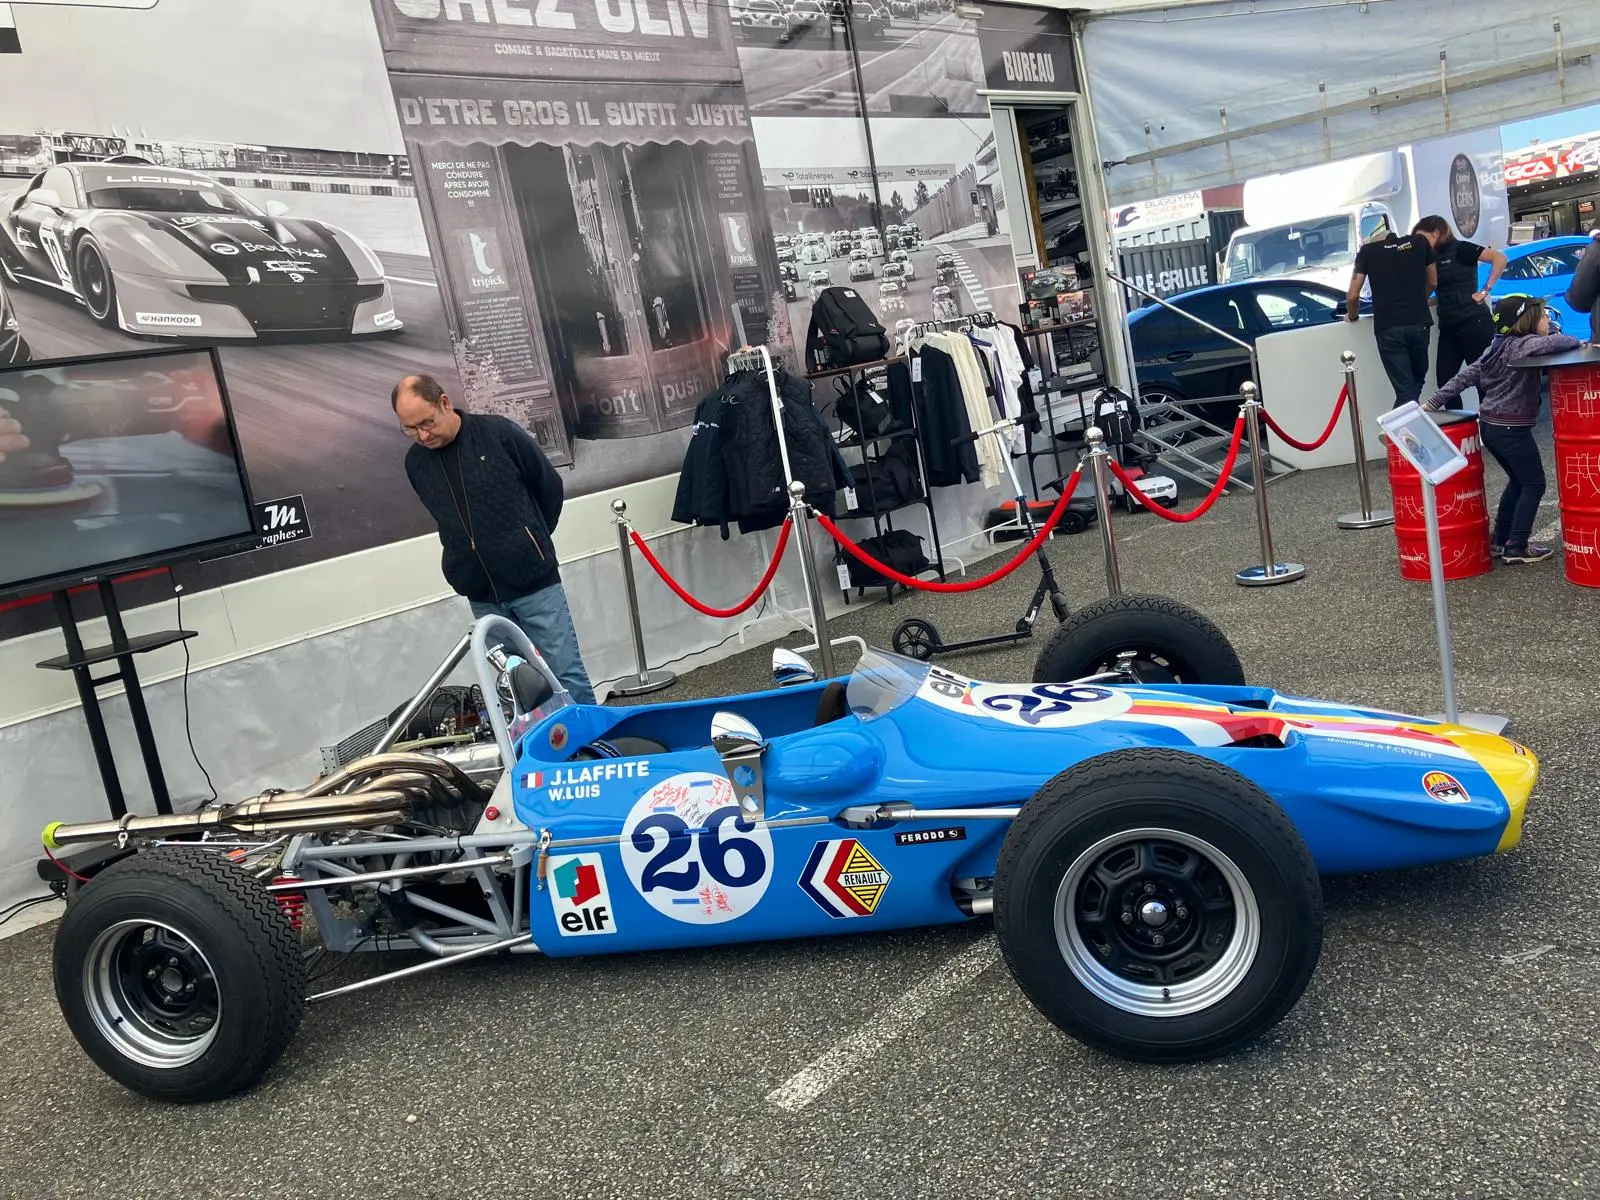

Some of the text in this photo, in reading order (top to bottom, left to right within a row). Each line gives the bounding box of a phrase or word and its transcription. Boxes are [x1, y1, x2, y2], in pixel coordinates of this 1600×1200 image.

[494, 43, 532, 56] COMME
[597, 49, 618, 60] MAIS
[621, 50, 633, 61] EN
[635, 51, 661, 62] MIEUX
[1002, 51, 1056, 83] BUREAU
[400, 96, 748, 127] D'ETRE GROS IL SUFFIT JUSTE
[431, 162, 455, 170] MERCI
[466, 161, 476, 169] NE
[477, 161, 490, 169] PAS
[446, 171, 483, 179] CONDUIRE
[468, 180, 490, 188] AVOIR
[472, 275, 505, 288] tripick
[982, 684, 1114, 726] 26
[550, 761, 650, 786] J.LAFFITE
[548, 784, 600, 801] W.LUIS
[901, 831, 945, 843] FERODO
[631, 806, 766, 892] 26
[844, 872, 883, 886] RENAULT
[561, 907, 609, 932] elf
